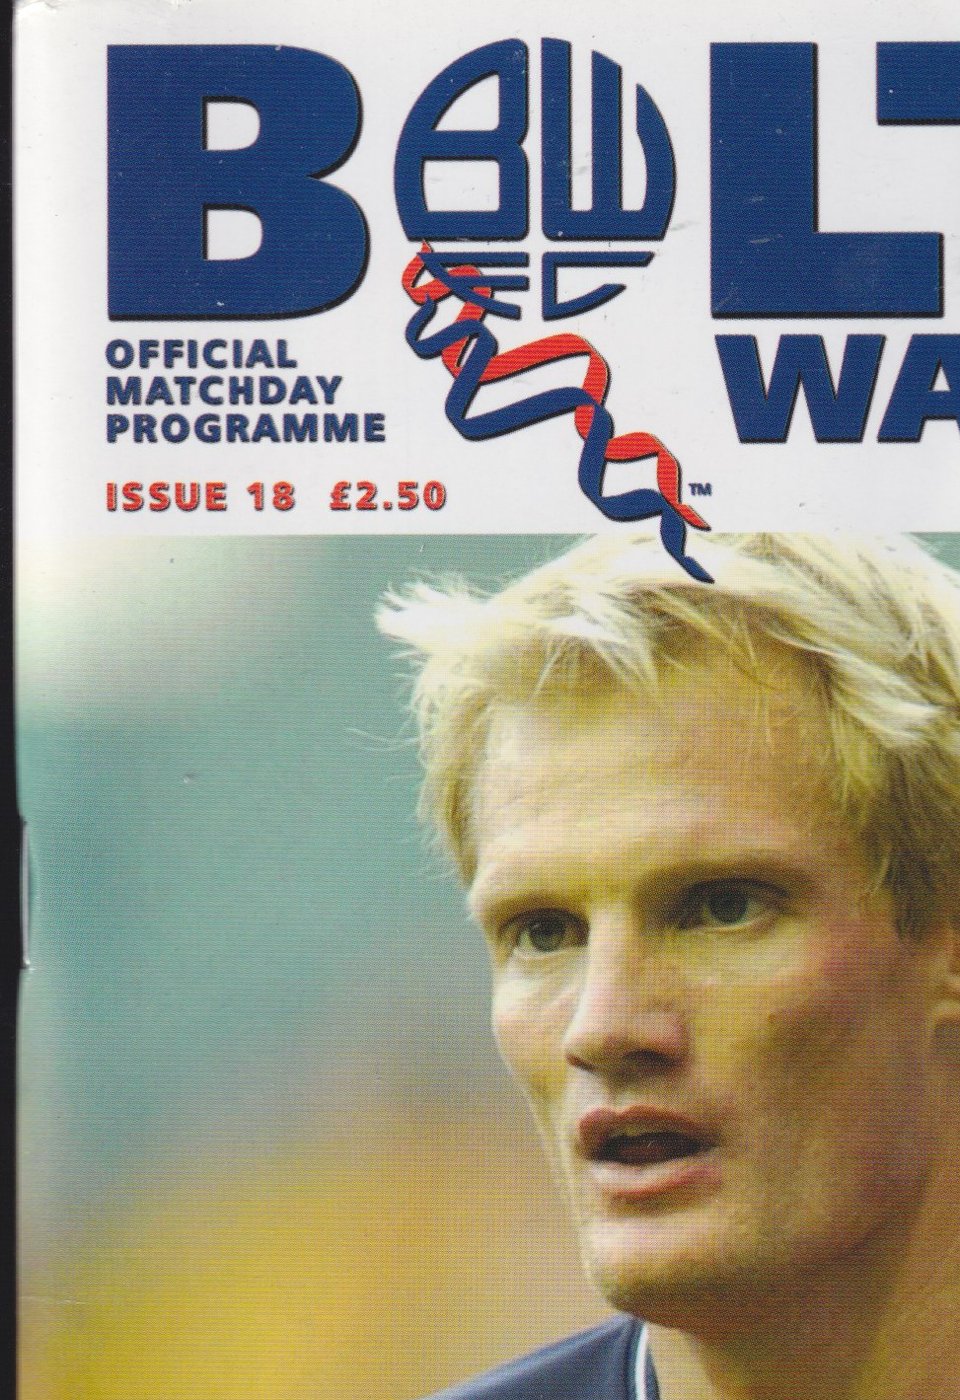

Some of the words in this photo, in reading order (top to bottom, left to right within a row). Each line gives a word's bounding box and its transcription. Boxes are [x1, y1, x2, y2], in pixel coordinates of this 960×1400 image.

[105, 338, 298, 370] OFFICIAL
[105, 375, 343, 406] MATCHDAY
[105, 412, 386, 444] PROGRAMME
[106, 480, 228, 512] ISSUE
[247, 480, 296, 512] 18
[329, 480, 447, 512] £2.50
